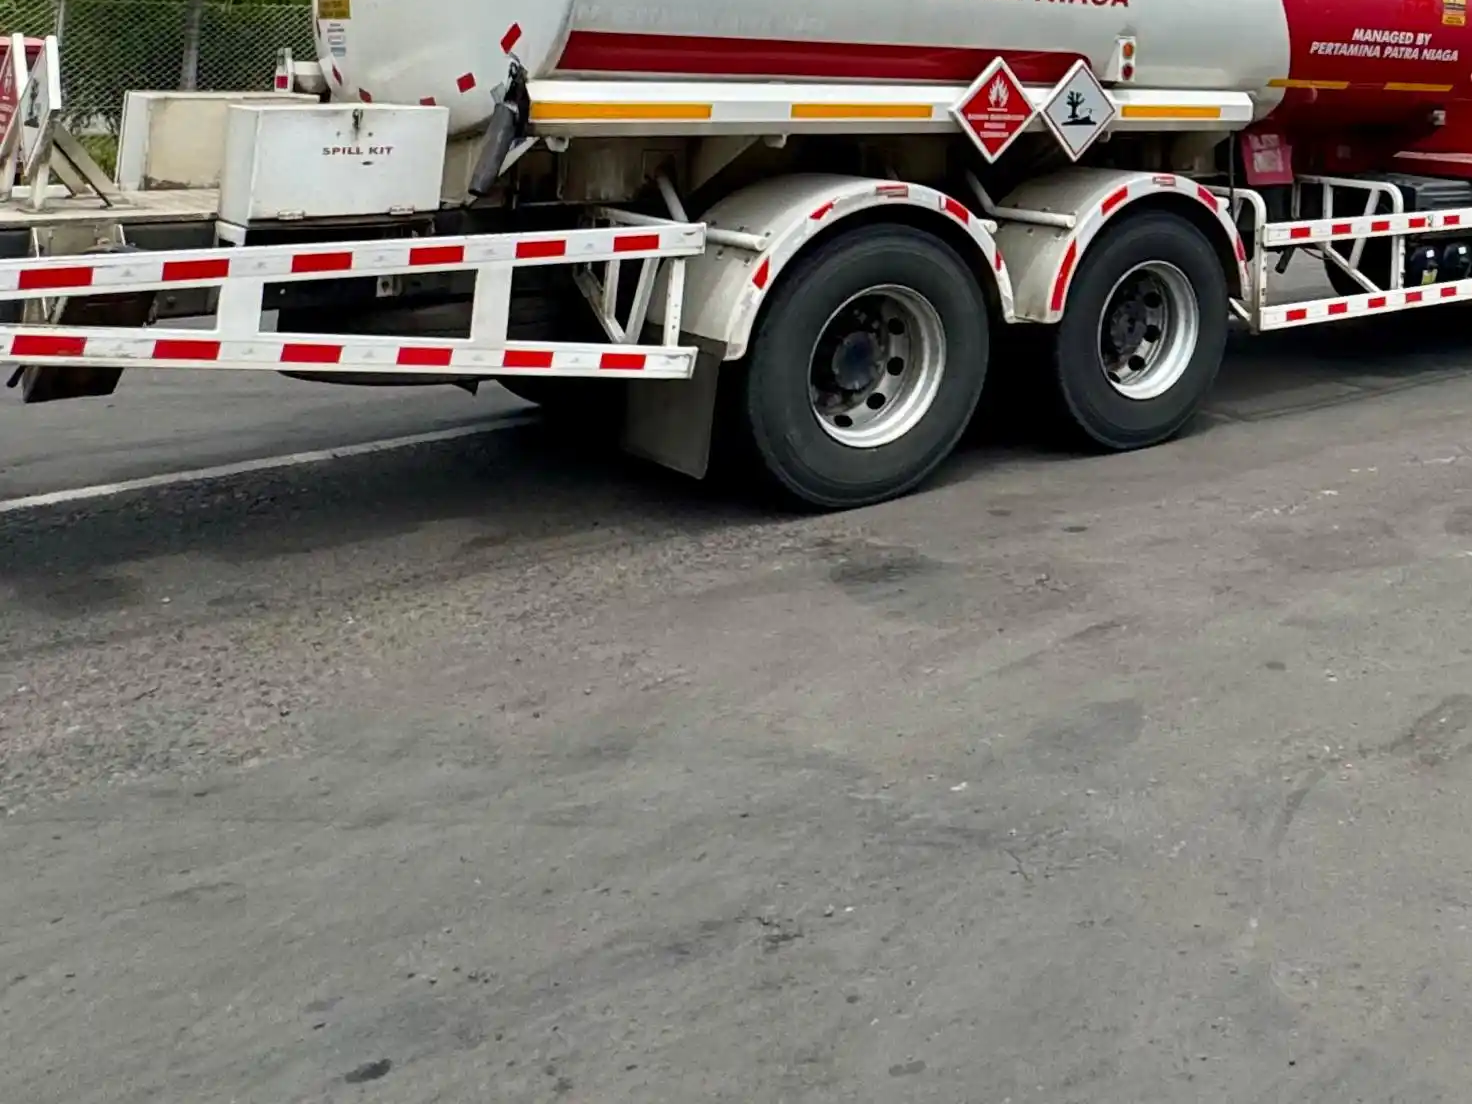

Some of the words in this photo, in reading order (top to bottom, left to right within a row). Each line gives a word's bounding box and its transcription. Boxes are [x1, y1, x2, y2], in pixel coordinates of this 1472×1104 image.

[1352, 28, 1413, 45] MANAGED
[1415, 32, 1432, 46] BY
[1309, 42, 1381, 58] PERTAMINA
[1383, 46, 1419, 60] PATRA
[1421, 49, 1458, 62] NIAGA
[322, 146, 363, 156] SPILL
[369, 146, 394, 155] KIT
